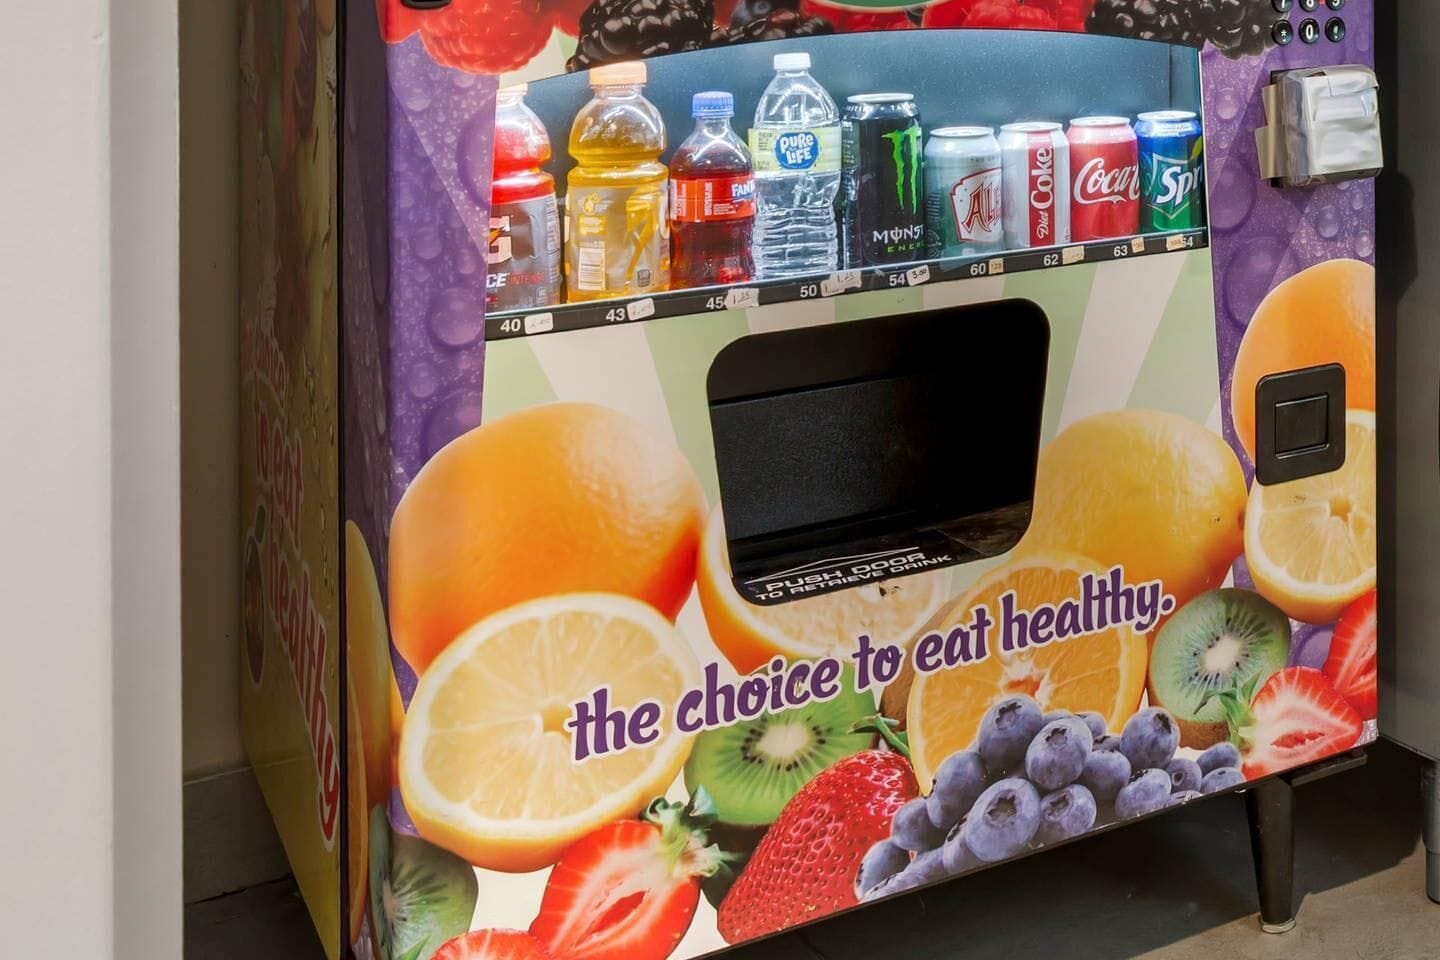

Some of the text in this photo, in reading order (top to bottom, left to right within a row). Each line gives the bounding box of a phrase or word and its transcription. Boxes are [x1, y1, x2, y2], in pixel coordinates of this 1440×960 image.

[1306, 25, 1313, 39] 0
[1031, 146, 1053, 210] Coke
[872, 224, 924, 245] MONST
[887, 241, 925, 253] ENER
[1113, 245, 1128, 257] 63
[1043, 254, 1059, 266] 62
[970, 263, 986, 276] 60
[889, 273, 906, 287] 54
[800, 285, 817, 298] 50
[706, 298, 724, 310] 45
[605, 308, 626, 322] 43
[500, 318, 521, 332] 40
[755, 555, 952, 600] TO RETRIEVE DRINK
[765, 552, 926, 592] PUSH DOOR
[568, 568, 1175, 760] the choice to eat healthy.
